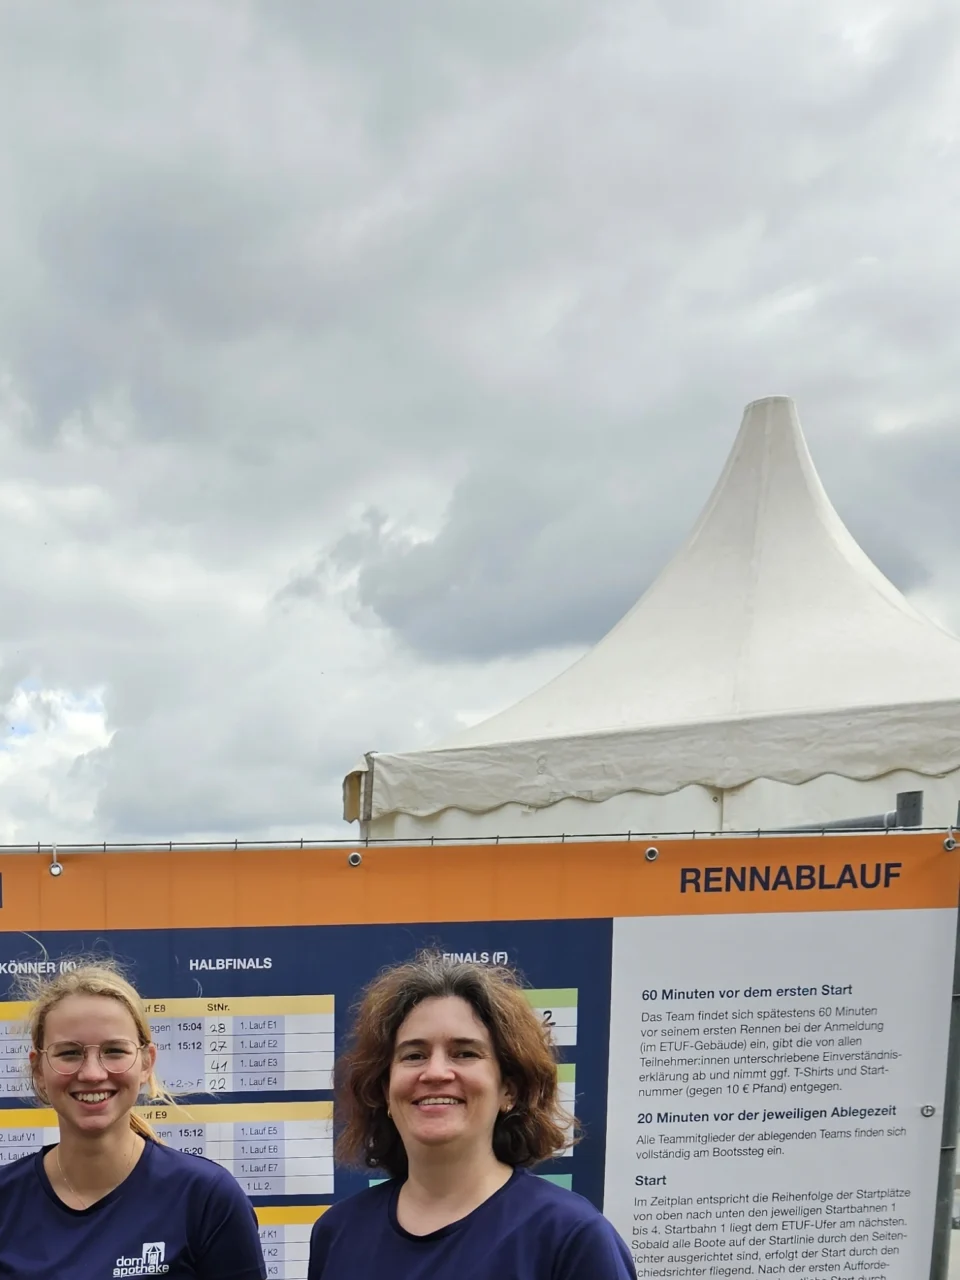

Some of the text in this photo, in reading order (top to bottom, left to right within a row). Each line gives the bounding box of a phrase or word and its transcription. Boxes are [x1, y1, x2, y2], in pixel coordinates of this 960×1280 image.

[680, 863, 902, 893] RENNABLAUF
[190, 958, 272, 971] HALBFINALS
[442, 951, 508, 965] FINALS (F)
[641, 984, 852, 1001] 60 Minuten vor dem ersten Start
[207, 1004, 230, 1012] StNr.
[641, 1006, 877, 1022] Das Team findet sich spätestens 60 Minuten
[210, 1024, 226, 1034] 28
[240, 1021, 277, 1030] 1. Lauf E1
[640, 1020, 884, 1037] vor seinem ersten Rennen bei der Anmeldung
[209, 1042, 227, 1052] 27
[639, 1036, 862, 1054] (im ETUF-Gebäude) ein, gibt die von allen
[639, 1049, 902, 1067] Teilnehmer:innen unterschriebene Einverständnis-
[211, 1060, 227, 1071] 41
[638, 1064, 889, 1083] erklärung ab und nimmt ggf. T-Shirts und Start-
[209, 1078, 226, 1090] 22
[638, 1082, 842, 1098] nummer (gegen 10 € Pfand) entgegen.
[637, 1104, 896, 1124] 20 Minuten vor der jeweiligen Ablegezeit
[635, 1127, 906, 1145] Alle Teammitglieder der ablegenden Teams finden sich
[635, 1145, 784, 1160] vollständig am Bootssteg ein.
[634, 1175, 667, 1186] Start
[116, 1256, 145, 1267] dom
[113, 1262, 169, 1276] apotheke
